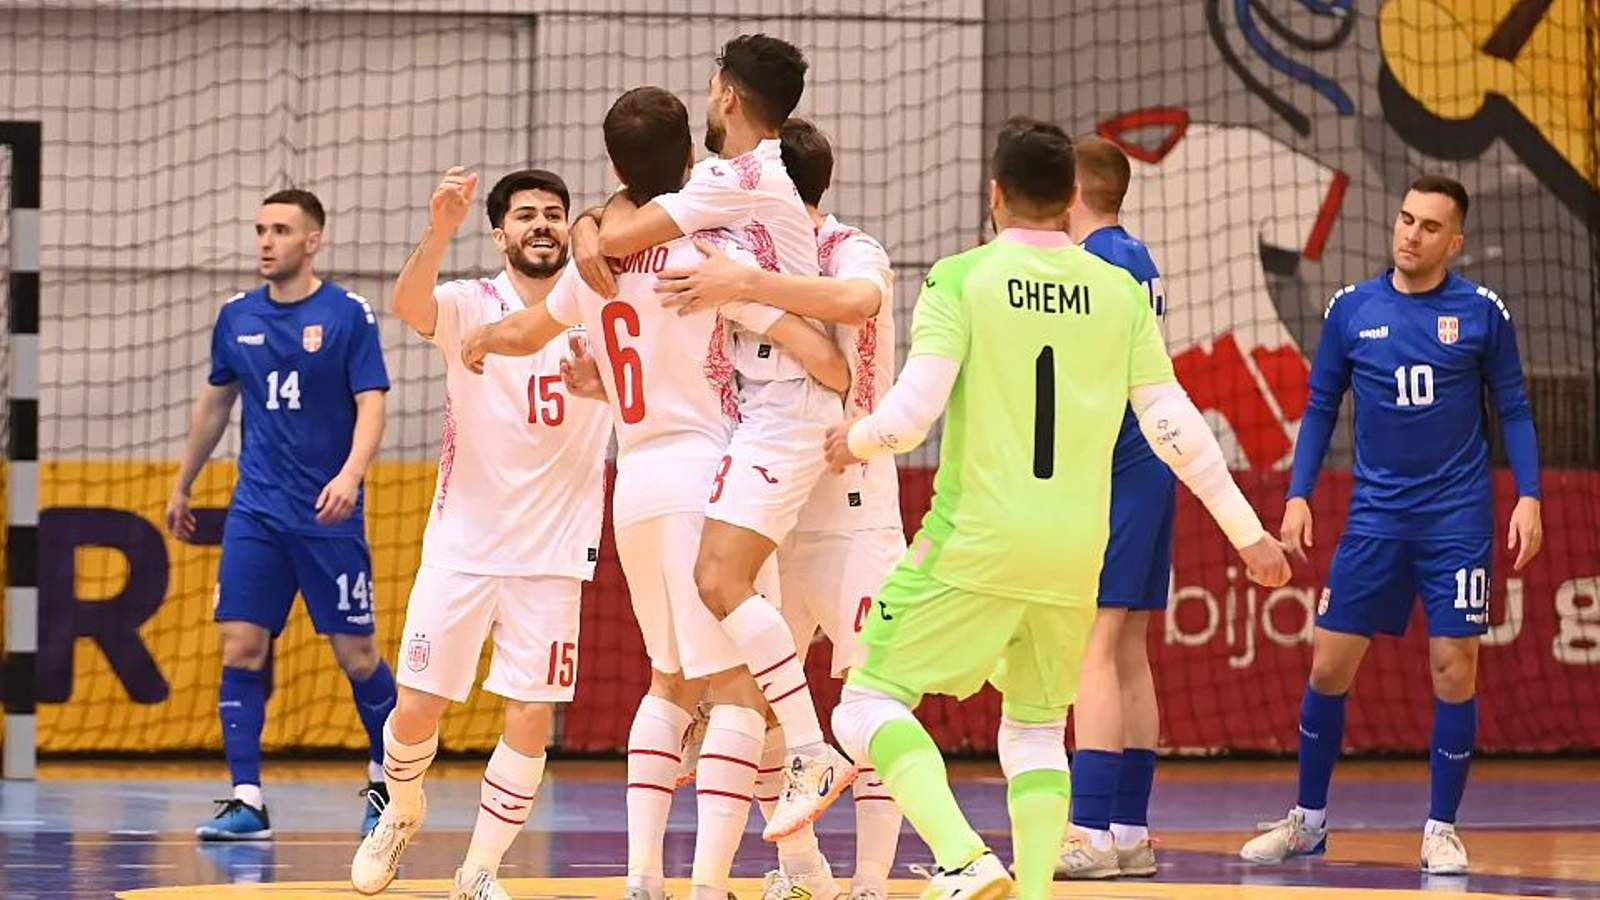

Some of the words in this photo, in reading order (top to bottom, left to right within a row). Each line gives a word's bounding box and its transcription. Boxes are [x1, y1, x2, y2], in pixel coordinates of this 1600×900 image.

[1007, 278, 1091, 316] CHEMI
[600, 300, 646, 425] 6
[266, 370, 301, 410] 14
[527, 374, 565, 427] 15
[1394, 364, 1434, 406] 10
[1032, 345, 1056, 480] 1
[336, 571, 369, 610] 14
[1454, 567, 1486, 609] 10
[546, 640, 575, 687] 15
